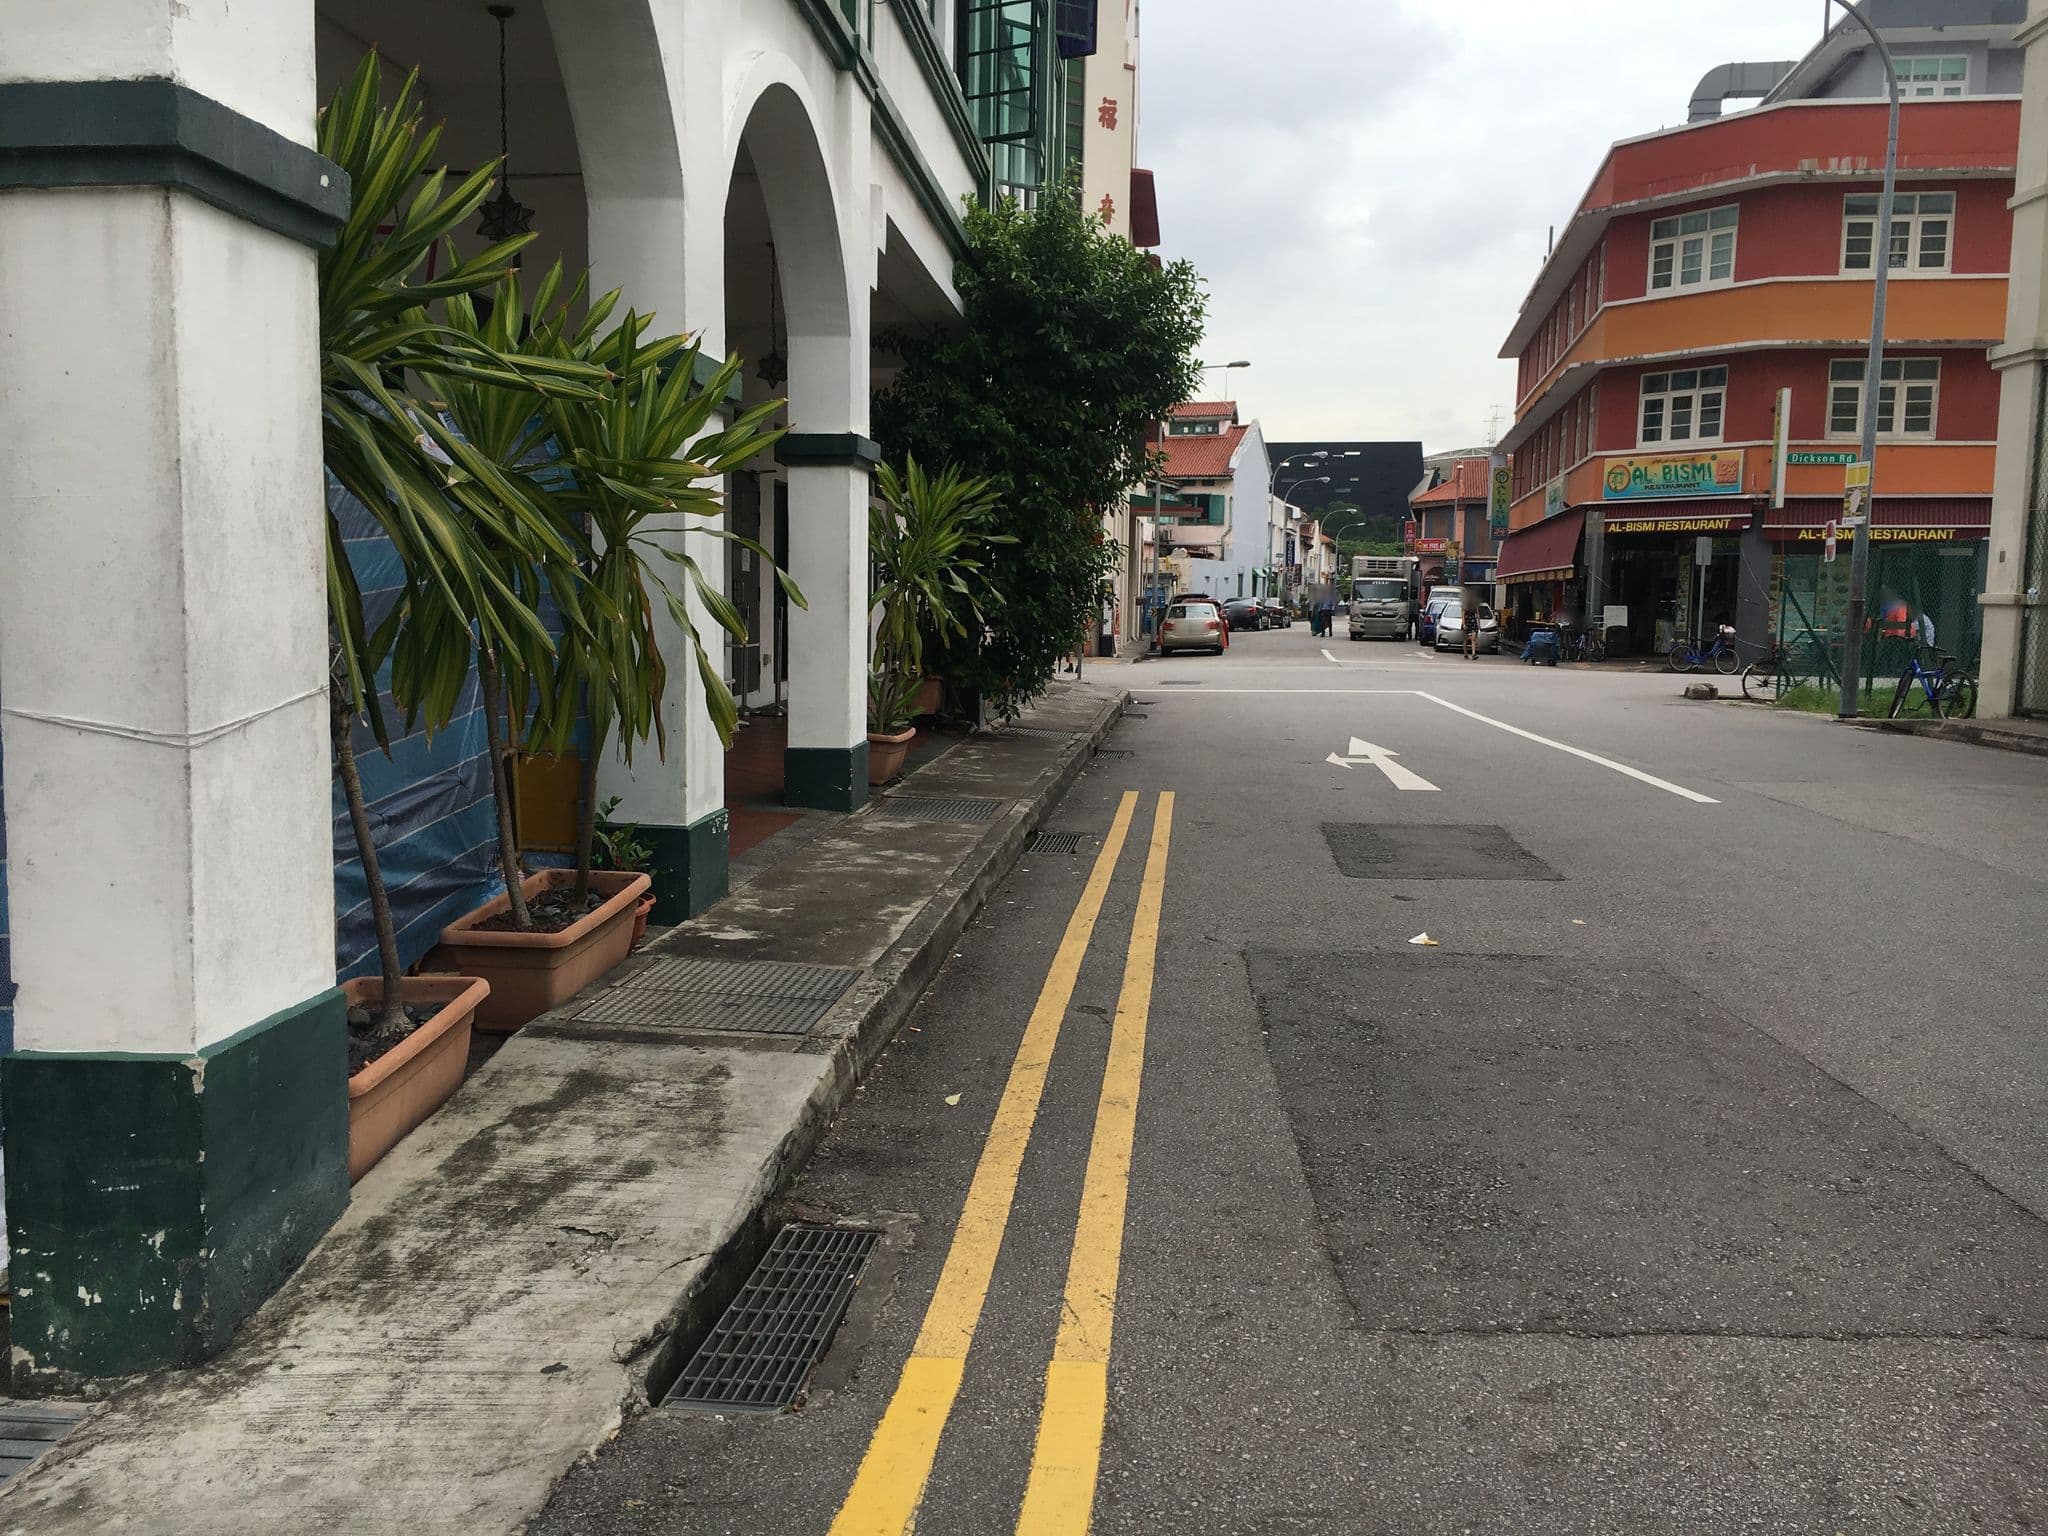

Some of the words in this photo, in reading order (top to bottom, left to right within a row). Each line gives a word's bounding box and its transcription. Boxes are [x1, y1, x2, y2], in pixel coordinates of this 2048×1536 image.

[1792, 454, 1835, 463] Dickson
[1839, 454, 1852, 463] Rd
[1608, 522, 1655, 532] AL-BISMI
[1658, 520, 1731, 531] RESTAURANT
[1798, 530, 1855, 539] AL-BSM
[1868, 530, 1956, 539] RESTAURANT
